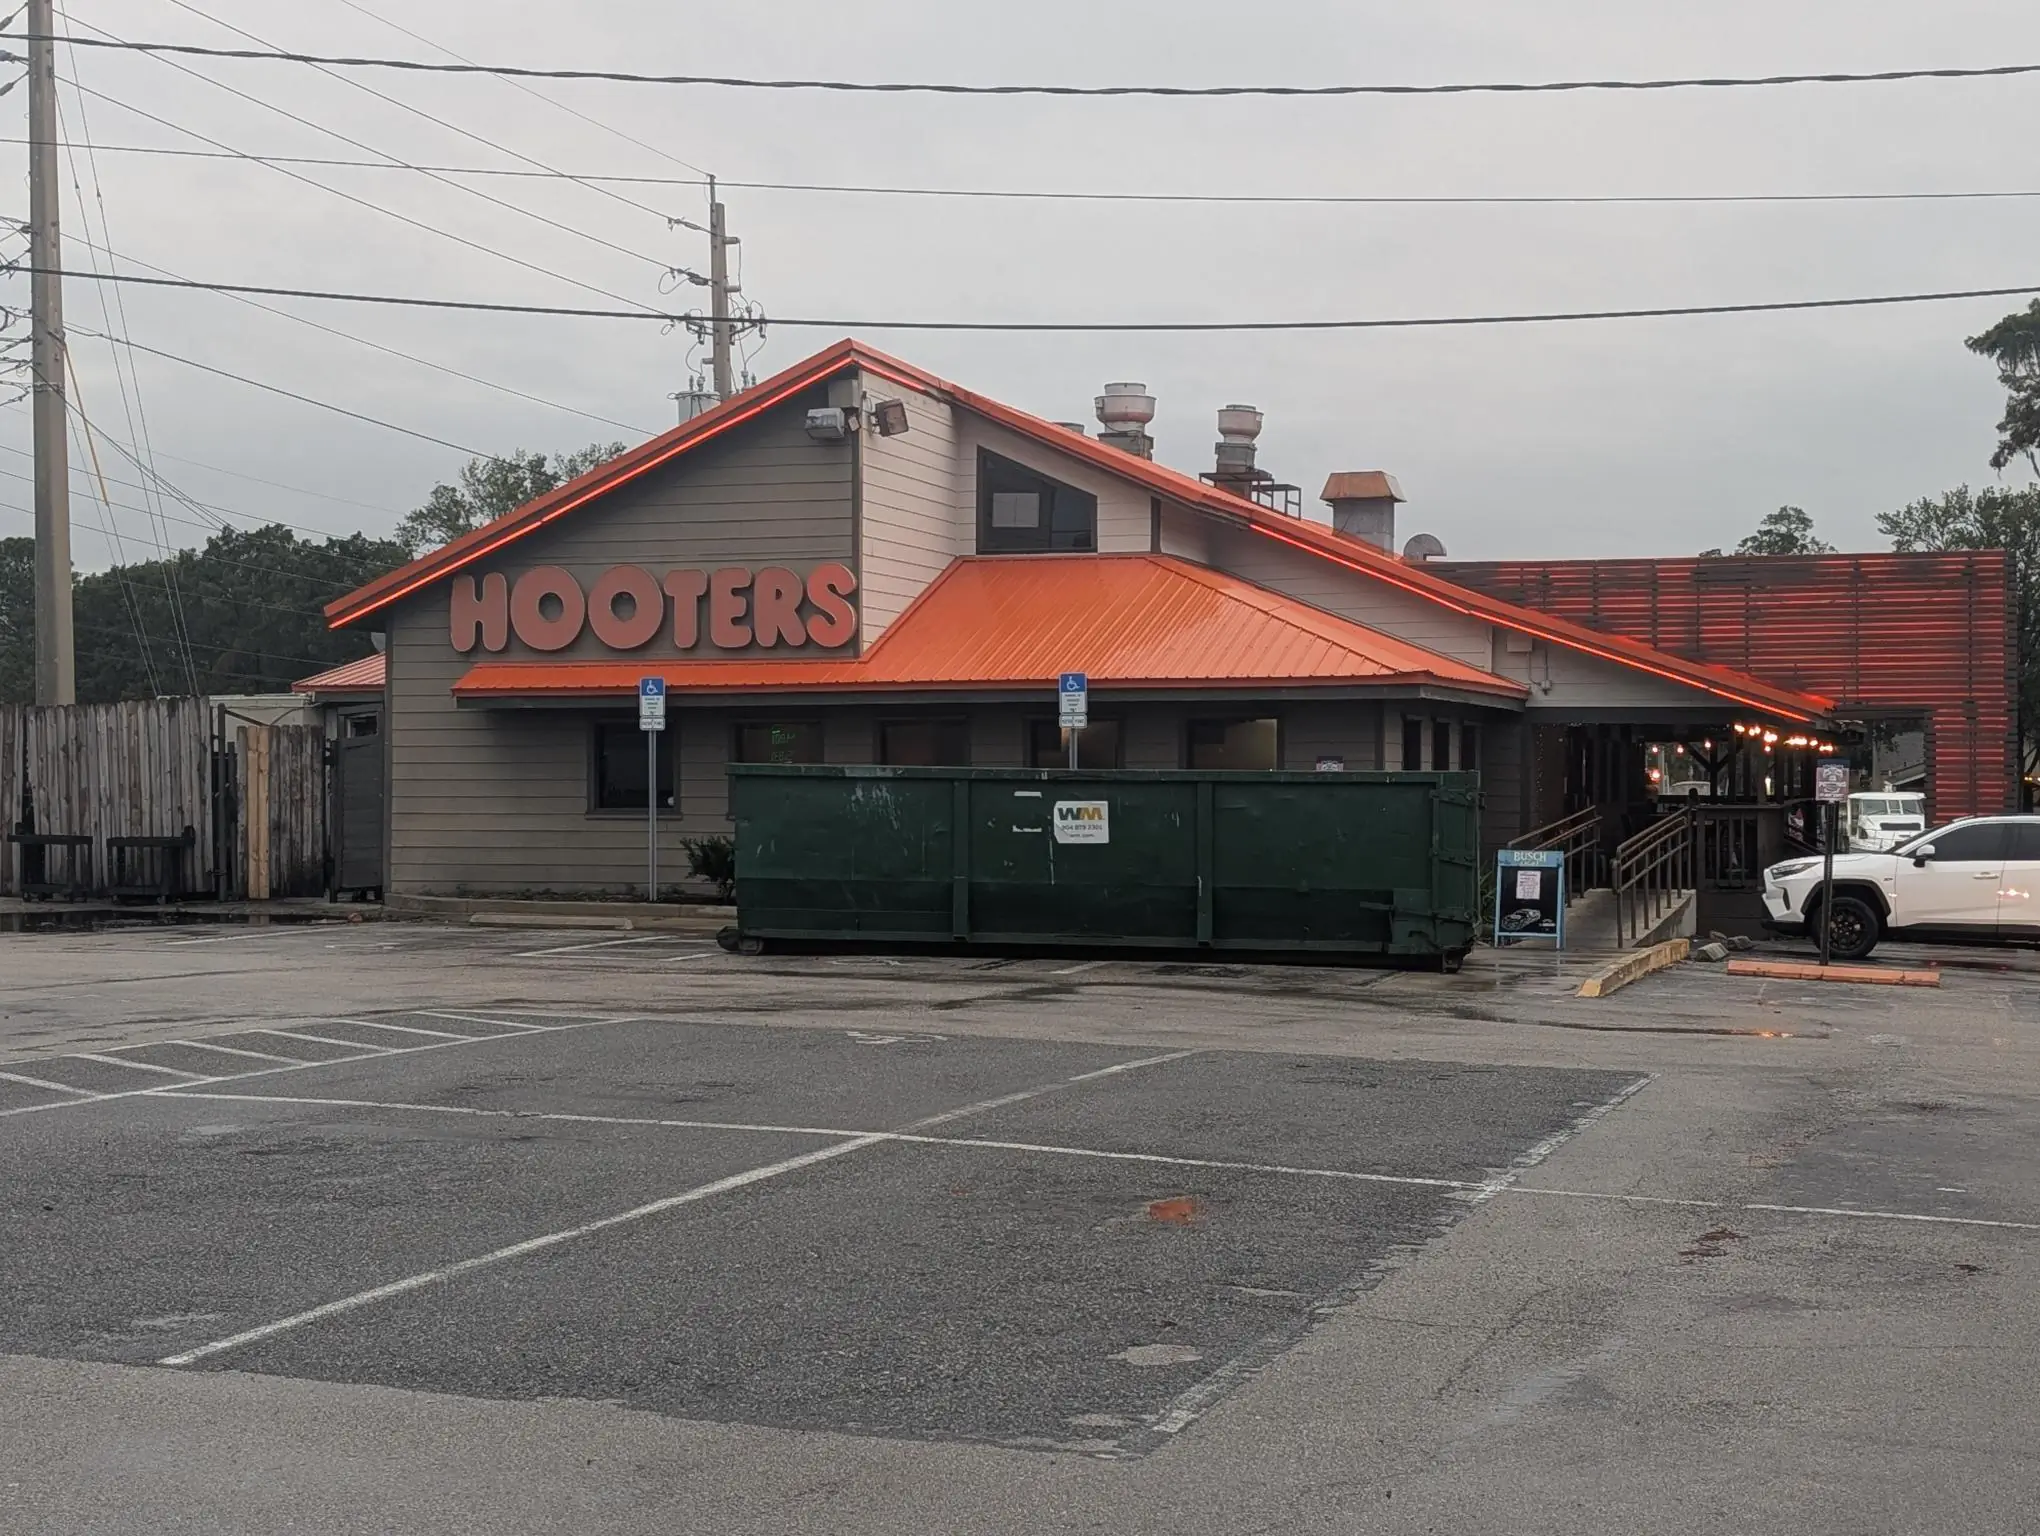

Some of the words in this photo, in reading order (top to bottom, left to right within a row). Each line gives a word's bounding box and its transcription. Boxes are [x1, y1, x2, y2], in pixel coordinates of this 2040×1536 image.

[450, 563, 858, 652] HOOTERS
[1057, 807, 1104, 821] WM
[1513, 851, 1547, 862] BUSCH
